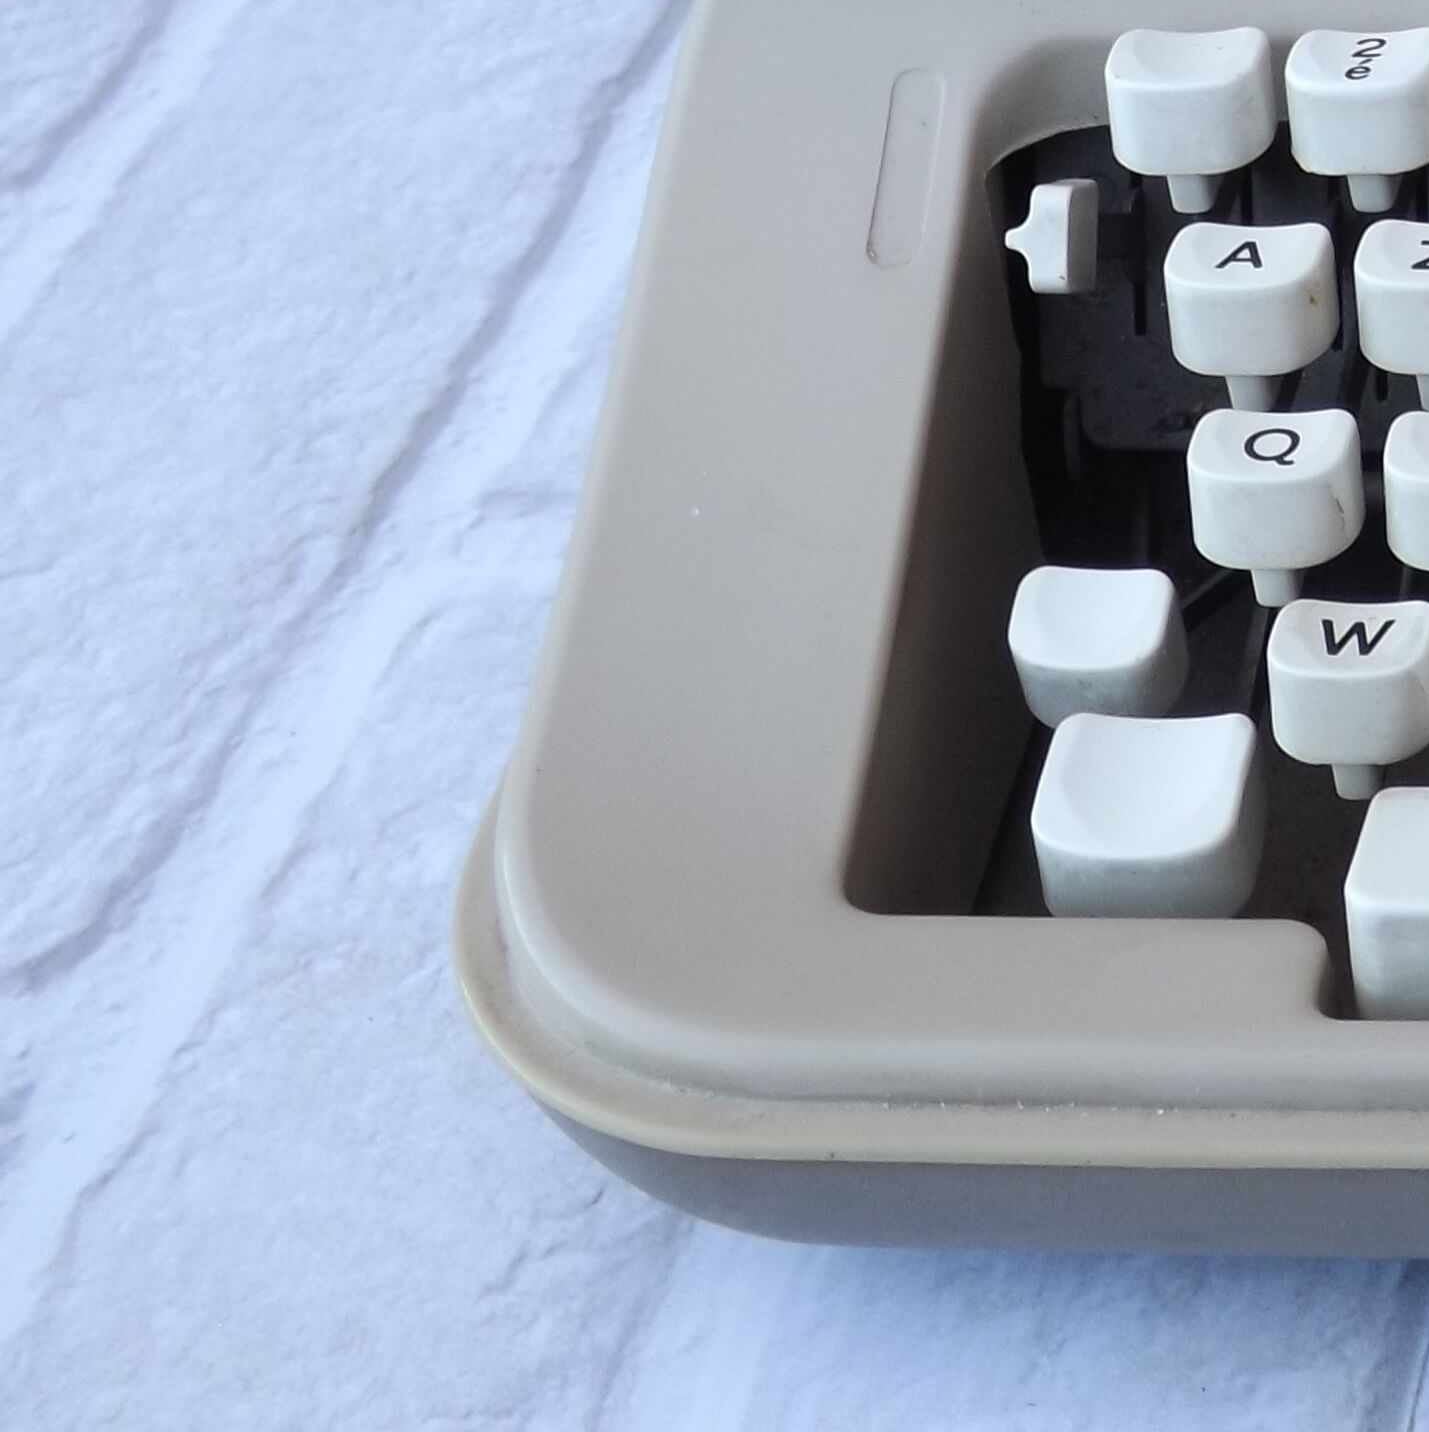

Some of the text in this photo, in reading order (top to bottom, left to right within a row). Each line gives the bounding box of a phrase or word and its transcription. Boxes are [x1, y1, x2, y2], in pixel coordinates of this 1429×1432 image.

[1351, 38, 1387, 58] 2
[1344, 58, 1373, 80] é
[1215, 241, 1263, 269] A
[1243, 428, 1301, 466] Q
[1321, 618, 1396, 656] W
